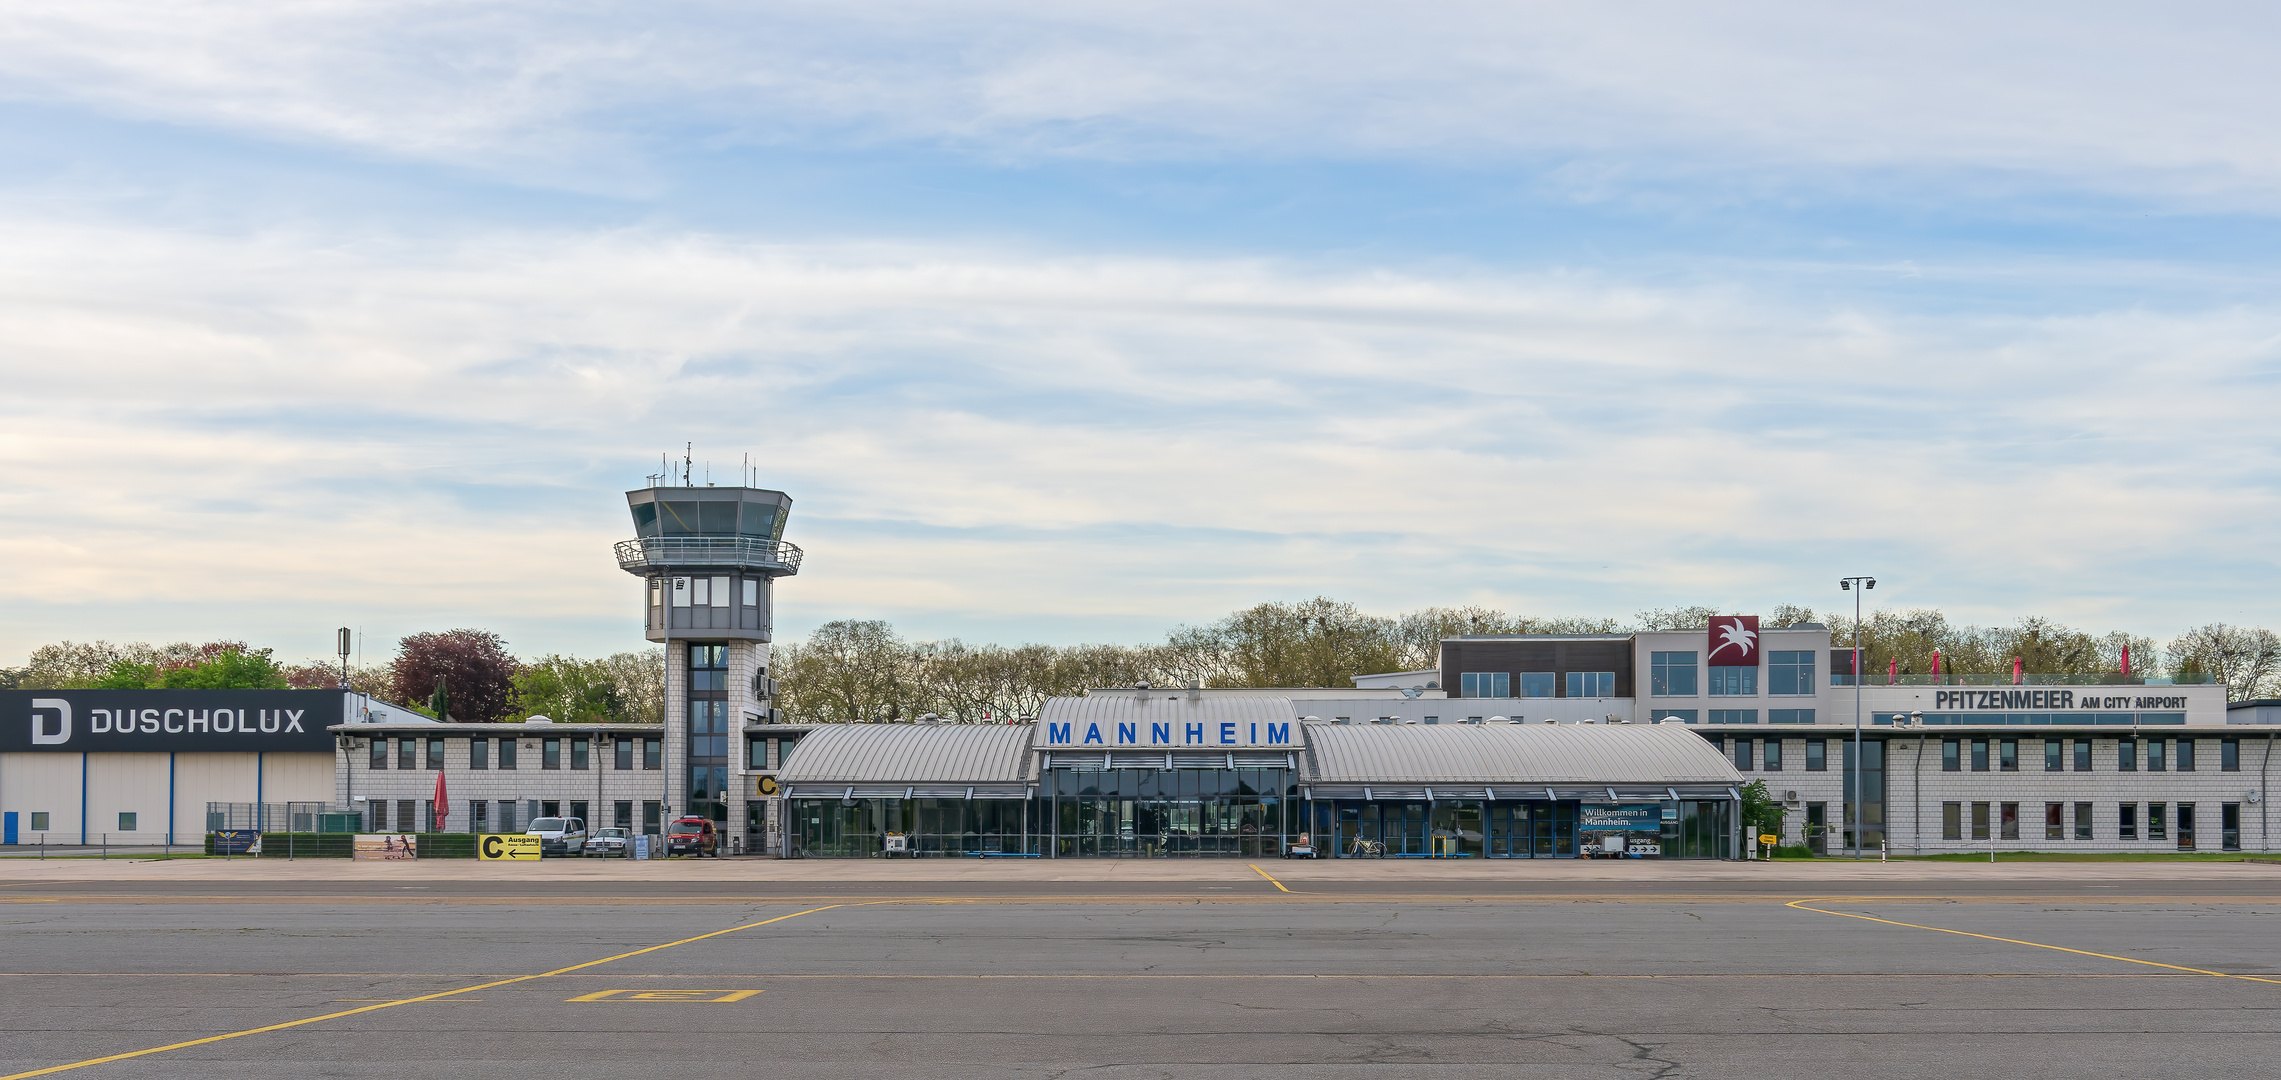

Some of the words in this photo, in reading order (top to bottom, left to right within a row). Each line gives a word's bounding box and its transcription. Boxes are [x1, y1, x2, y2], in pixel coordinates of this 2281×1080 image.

[1936, 690, 2074, 709] PFITZENMEIER
[2081, 697, 2102, 709] AM
[2104, 697, 2130, 709] CITY
[2135, 696, 2187, 709] AIRPORT
[91, 708, 305, 734] DUSCHOLUX
[1049, 722, 1290, 745] MANNHEIM
[758, 775, 777, 795] C
[1585, 808, 1638, 817] Willkommen
[1639, 808, 1648, 817] in
[1585, 817, 1631, 826] Mannheim.
[483, 836, 504, 858] C
